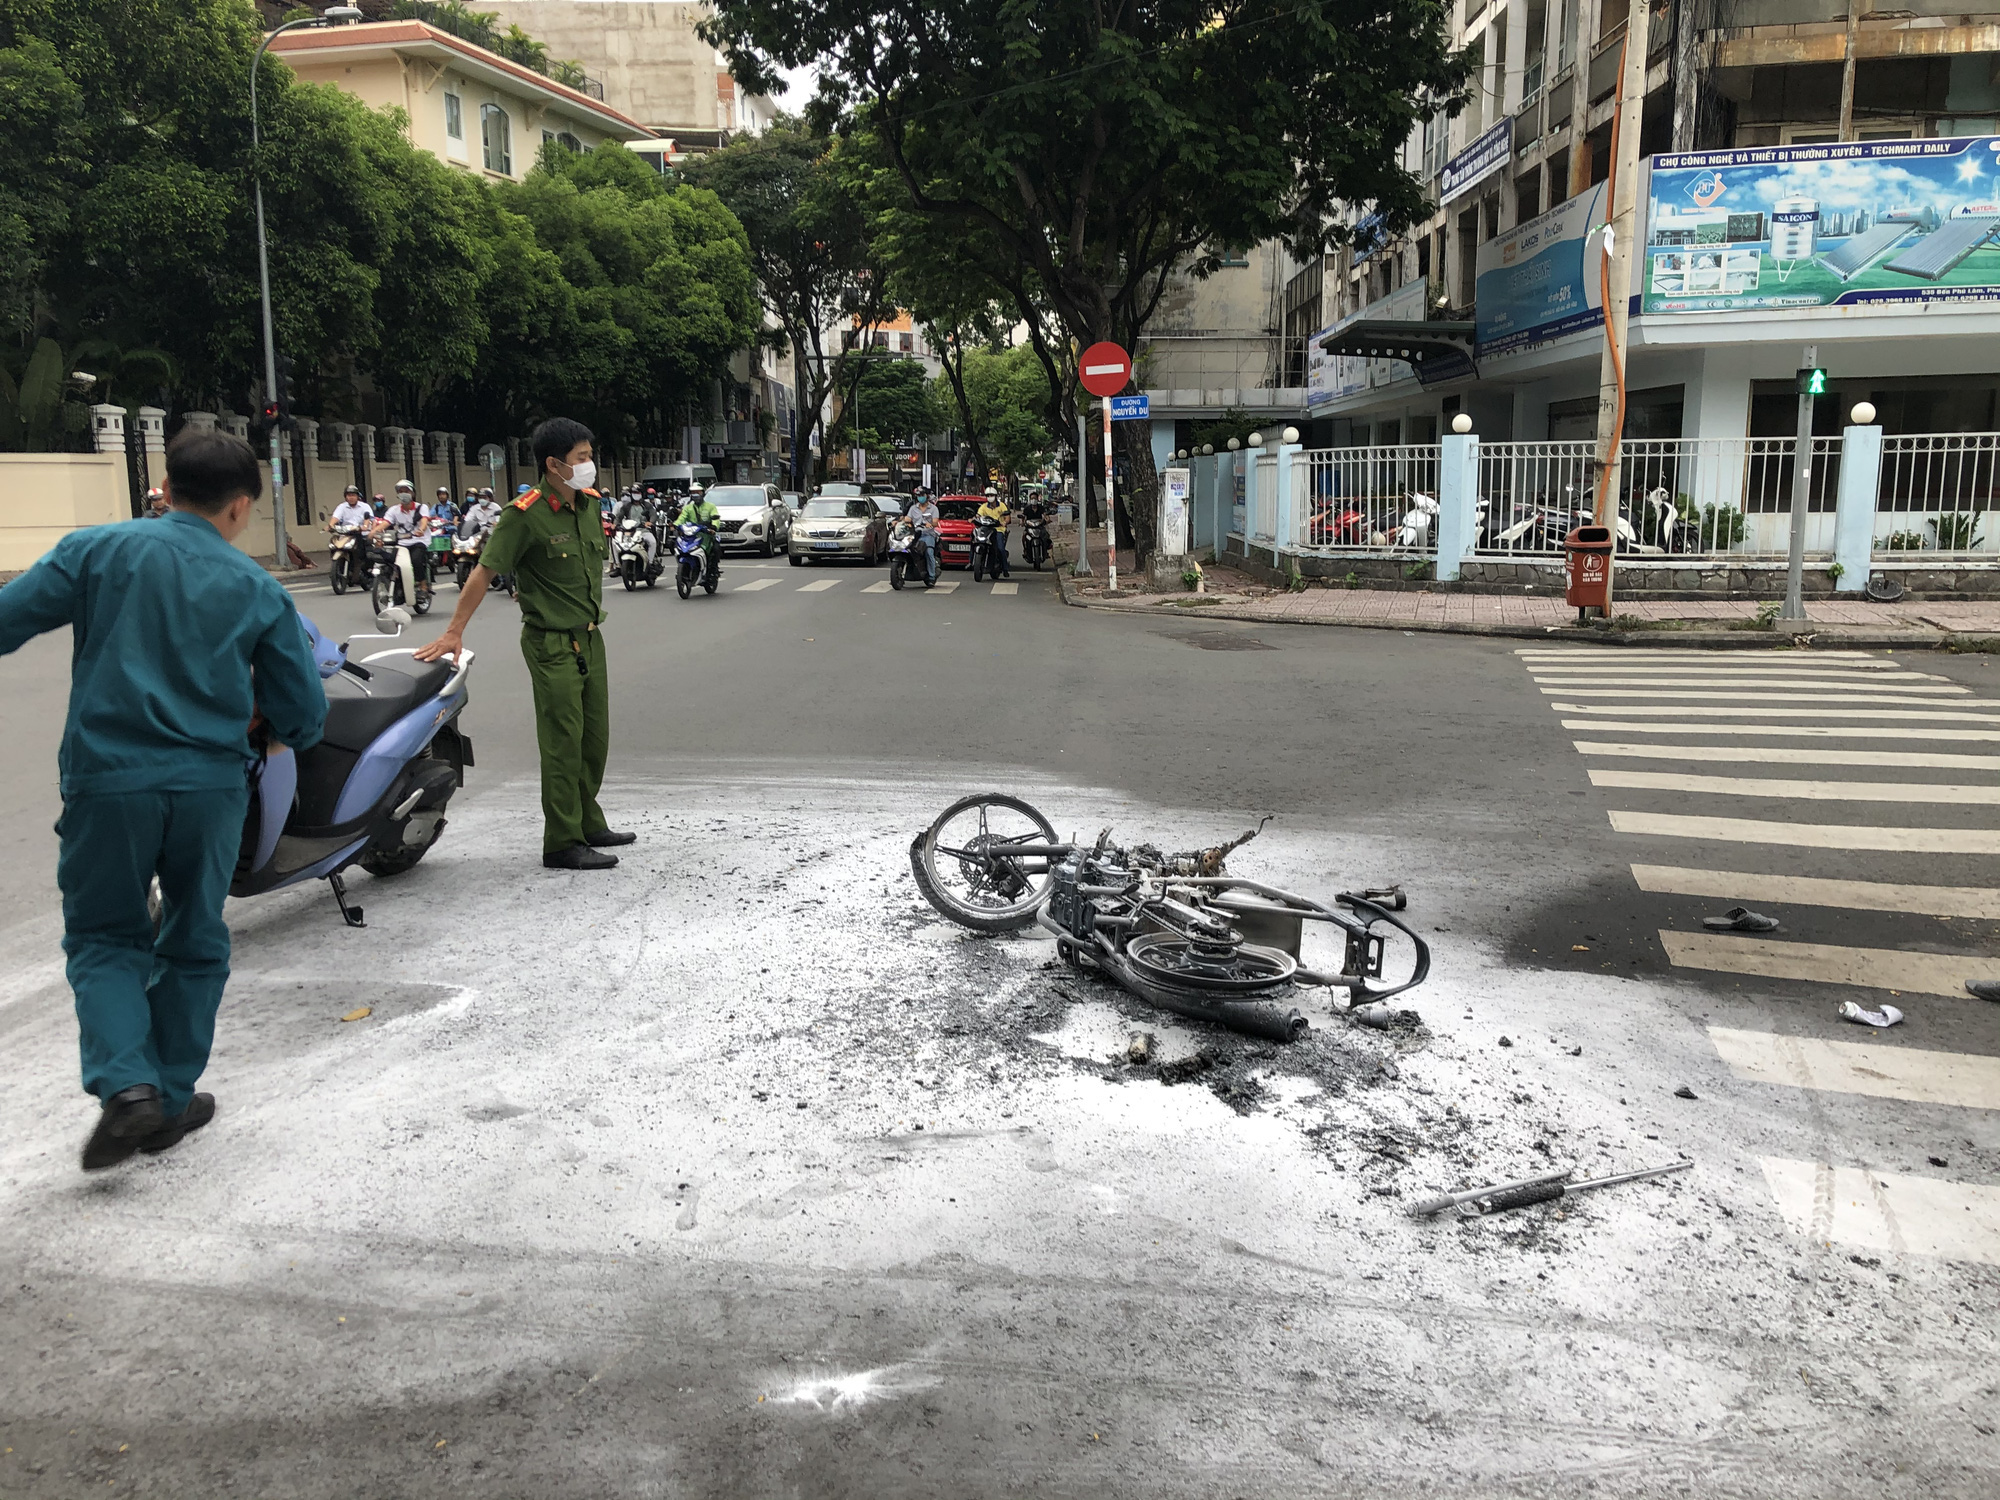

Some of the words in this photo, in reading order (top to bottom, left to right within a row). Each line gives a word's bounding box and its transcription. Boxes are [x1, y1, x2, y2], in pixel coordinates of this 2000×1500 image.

[1660, 156, 1679, 168] CHỢ
[1681, 154, 1706, 167] CÔNG
[1708, 152, 1733, 165] NGHỆ
[1736, 151, 1748, 163] VÀ
[1751, 149, 1776, 162] THIẾT
[1779, 151, 1788, 162] BỊ
[1791, 147, 1828, 161] THƯỜNG
[1831, 145, 1862, 157] XUYÊN
[1871, 144, 1922, 155] TECHMART
[1924, 143, 1951, 153] DAILY
[1777, 213, 1813, 222] SAIGON
[1780, 297, 1821, 305] Vinacontrol
[1113, 406, 1137, 416] NGUYỄN
